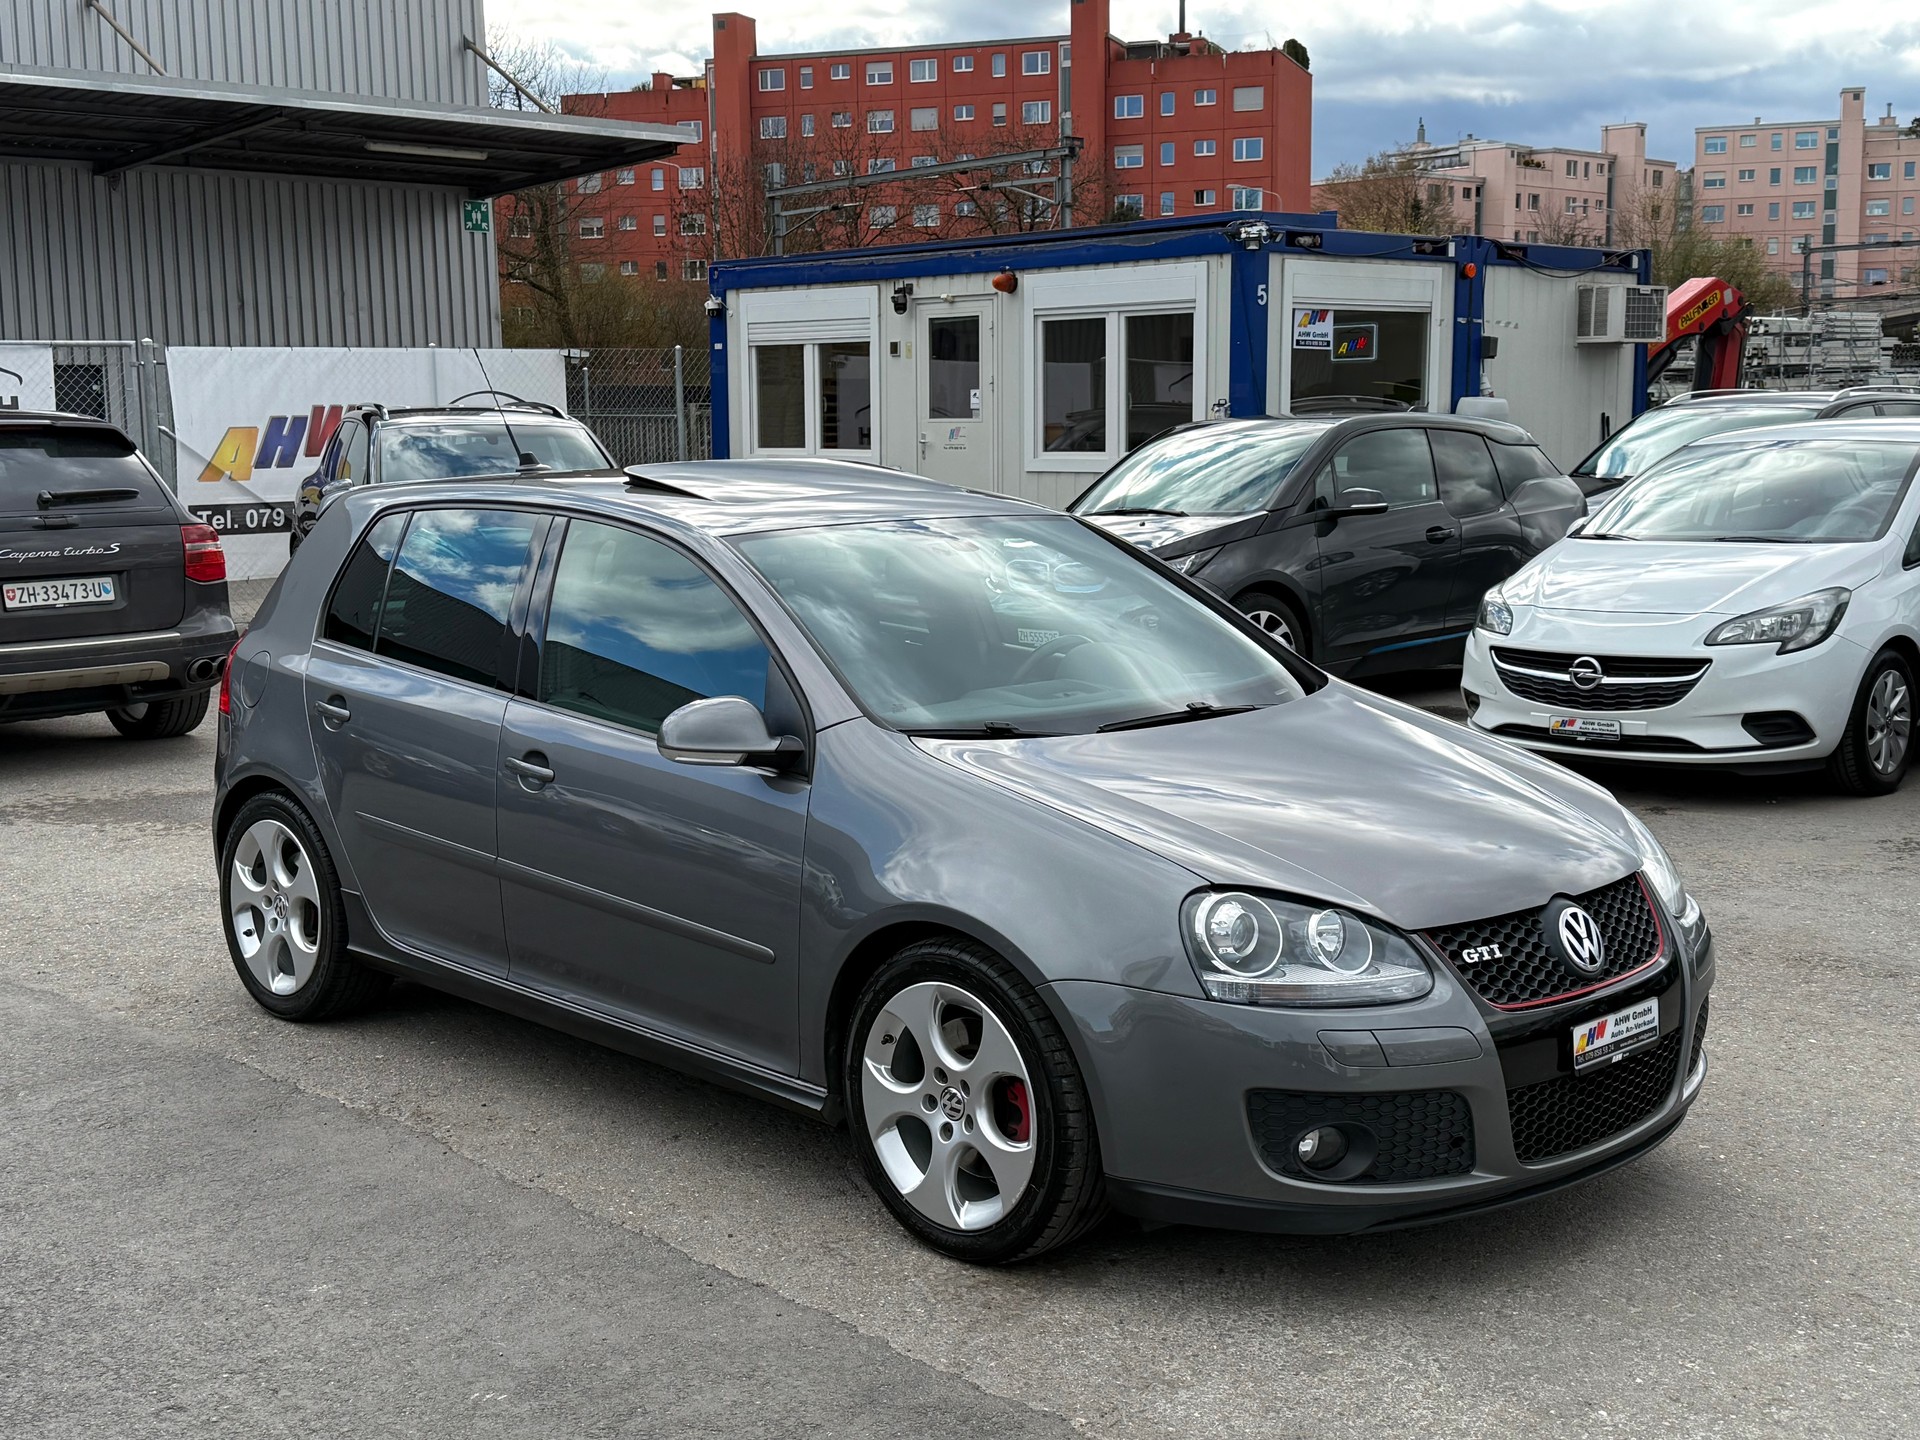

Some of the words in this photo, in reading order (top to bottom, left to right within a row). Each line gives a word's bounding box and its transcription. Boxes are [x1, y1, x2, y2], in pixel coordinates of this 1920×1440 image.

[1257, 284, 1267, 305] 5
[1297, 331, 1312, 339] AHW
[245, 507, 285, 528] 079
[0, 549, 61, 563] Cayenne
[1462, 944, 1502, 963] GTI
[1614, 1013, 1631, 1028] AHW
[1632, 1005, 1653, 1021] GmbH
[1576, 1019, 1608, 1054] AHW
[1610, 1029, 1624, 1039] Auto
[1625, 1016, 1656, 1033] An-Verkauf
